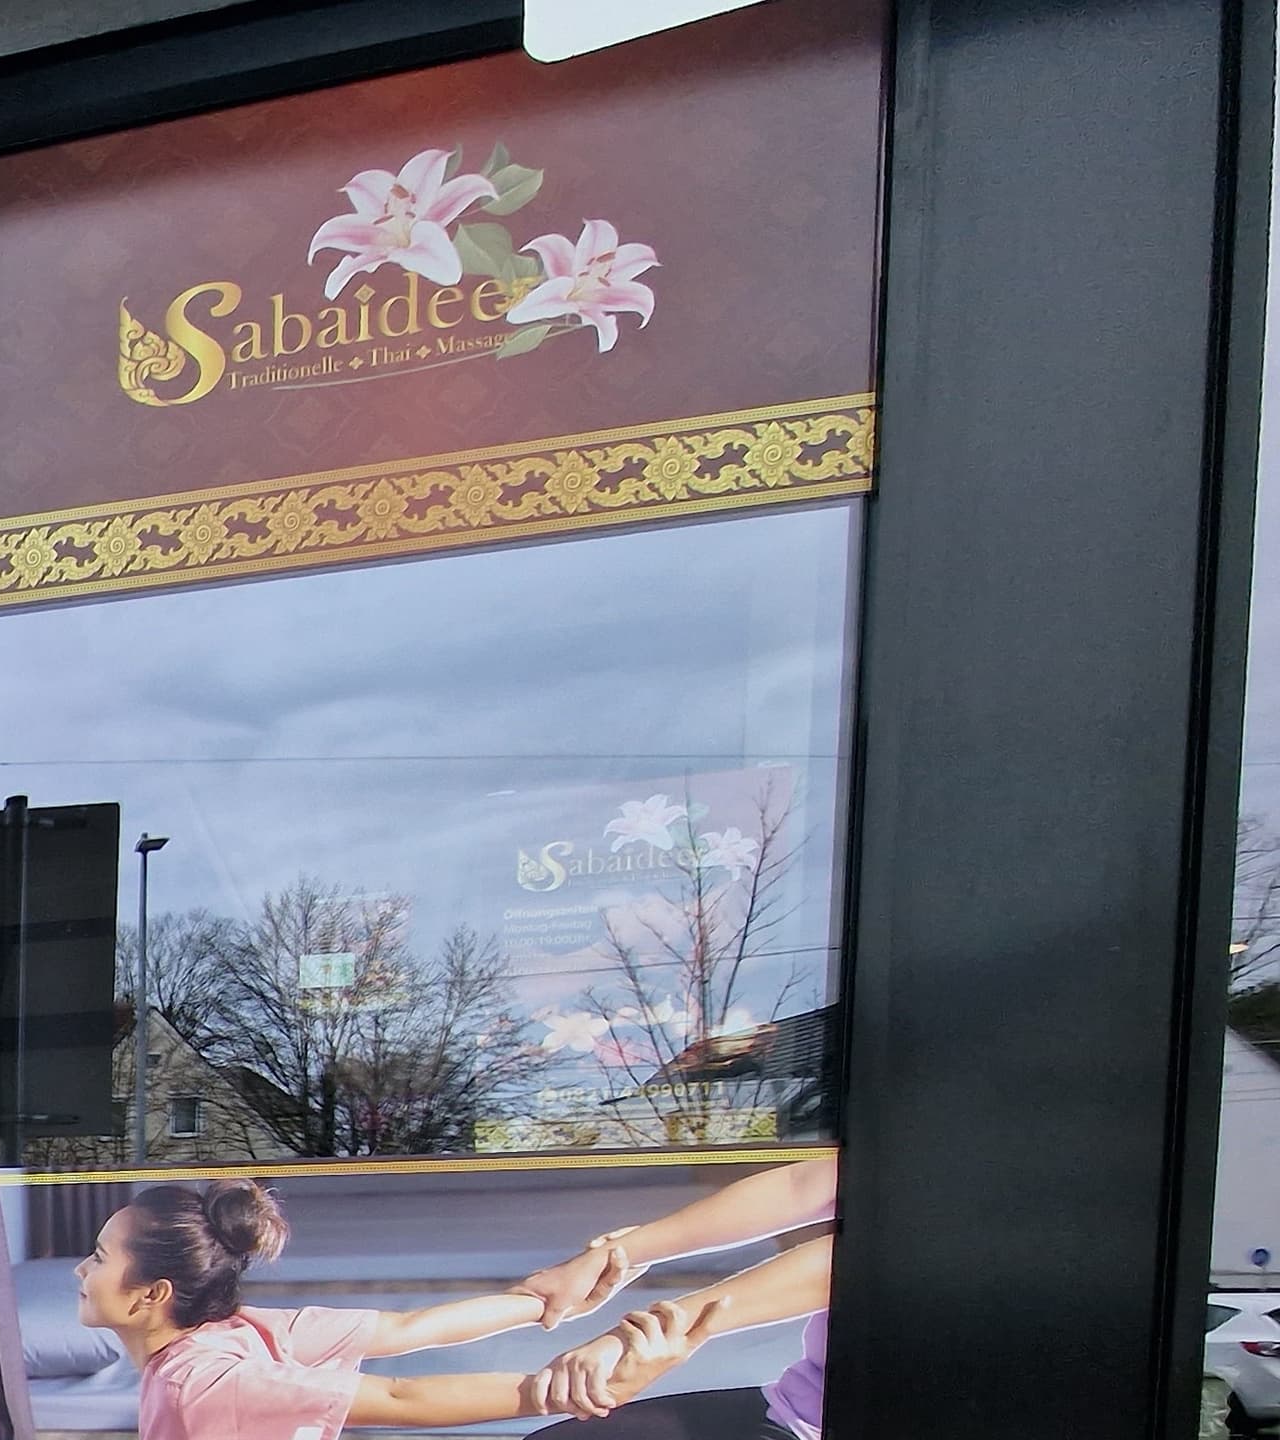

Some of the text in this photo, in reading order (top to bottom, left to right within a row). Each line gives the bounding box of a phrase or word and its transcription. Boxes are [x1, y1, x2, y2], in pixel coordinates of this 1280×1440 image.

[119, 272, 516, 406] Sabaidee
[227, 355, 342, 390] Traditionelle
[370, 345, 412, 367] Thai
